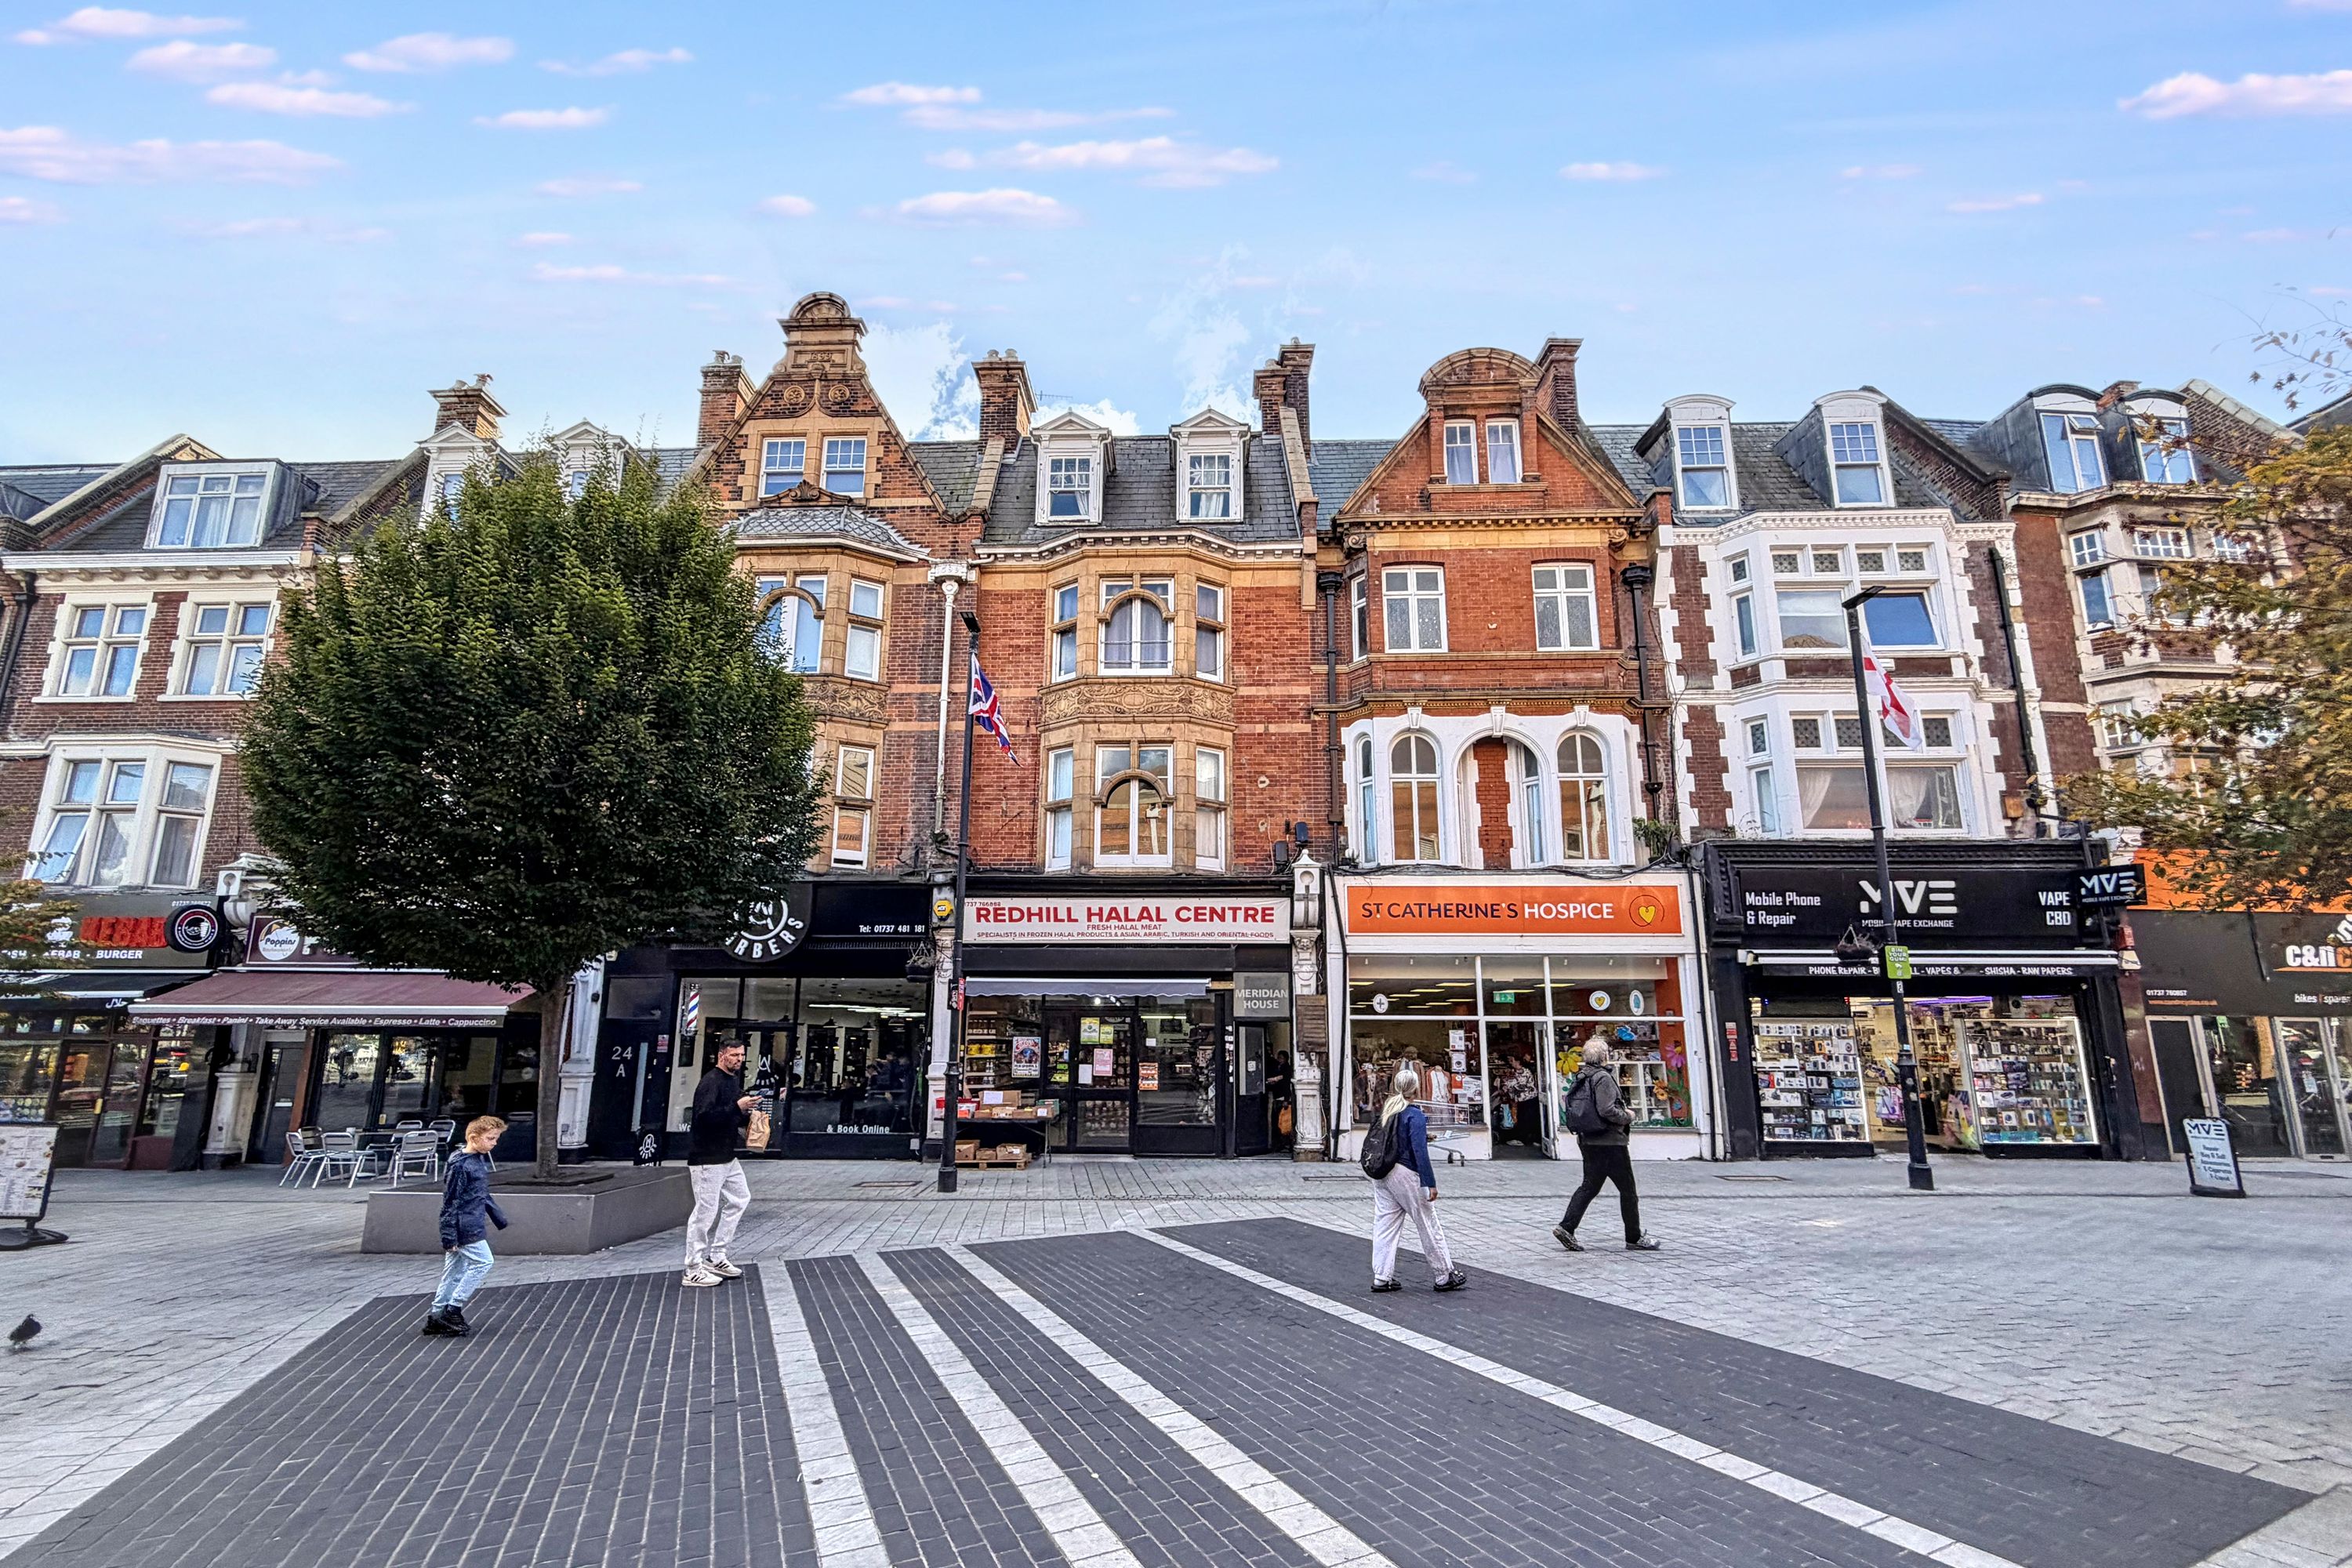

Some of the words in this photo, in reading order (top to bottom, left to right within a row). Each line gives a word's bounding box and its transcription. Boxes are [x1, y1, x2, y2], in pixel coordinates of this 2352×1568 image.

[2079, 871, 2136, 895] MVE
[1745, 891, 1783, 906] Mobile
[1786, 891, 1821, 906] Phone
[1858, 880, 1958, 913] MVE
[2038, 891, 2071, 906] VAPE
[975, 906, 1079, 924] REDHILL
[1087, 906, 1167, 923] HALAL
[1174, 906, 1275, 924] CENTRE
[1388, 902, 1519, 919] CATHERINE'S
[1524, 902, 1614, 920] HOSPICE
[1747, 911, 1755, 924] &
[1759, 911, 1796, 927] Repair
[1914, 919, 1955, 927] EXCHANGE
[2046, 911, 2071, 926] CBD
[265, 937, 296, 948] Poppins
[725, 917, 804, 958] RBERS
[43, 950, 81, 959] EBAB
[96, 950, 143, 959] BURGER
[1809, 966, 1837, 975] PHONE
[1838, 966, 1867, 975] REPAIR
[1926, 966, 1951, 975] VAPES
[1953, 966, 1961, 975] &
[1984, 967, 2016, 975] SHISHA
[2041, 967, 2074, 975] PAPERS
[1235, 989, 1288, 998] MERIDIAN
[2294, 993, 2318, 1003] bikes
[1243, 1000, 1279, 1009] HOUSE
[274, 1017, 297, 1025] Away
[373, 1018, 412, 1026] Espresso
[419, 1018, 441, 1026] Latte
[448, 1018, 496, 1027] Cappuccino
[612, 1046, 633, 1060] 24
[615, 1063, 626, 1077] A
[827, 1124, 833, 1133] &
[837, 1124, 859, 1134] Book
[862, 1124, 891, 1134] Online
[2186, 1122, 2226, 1137] MVE
